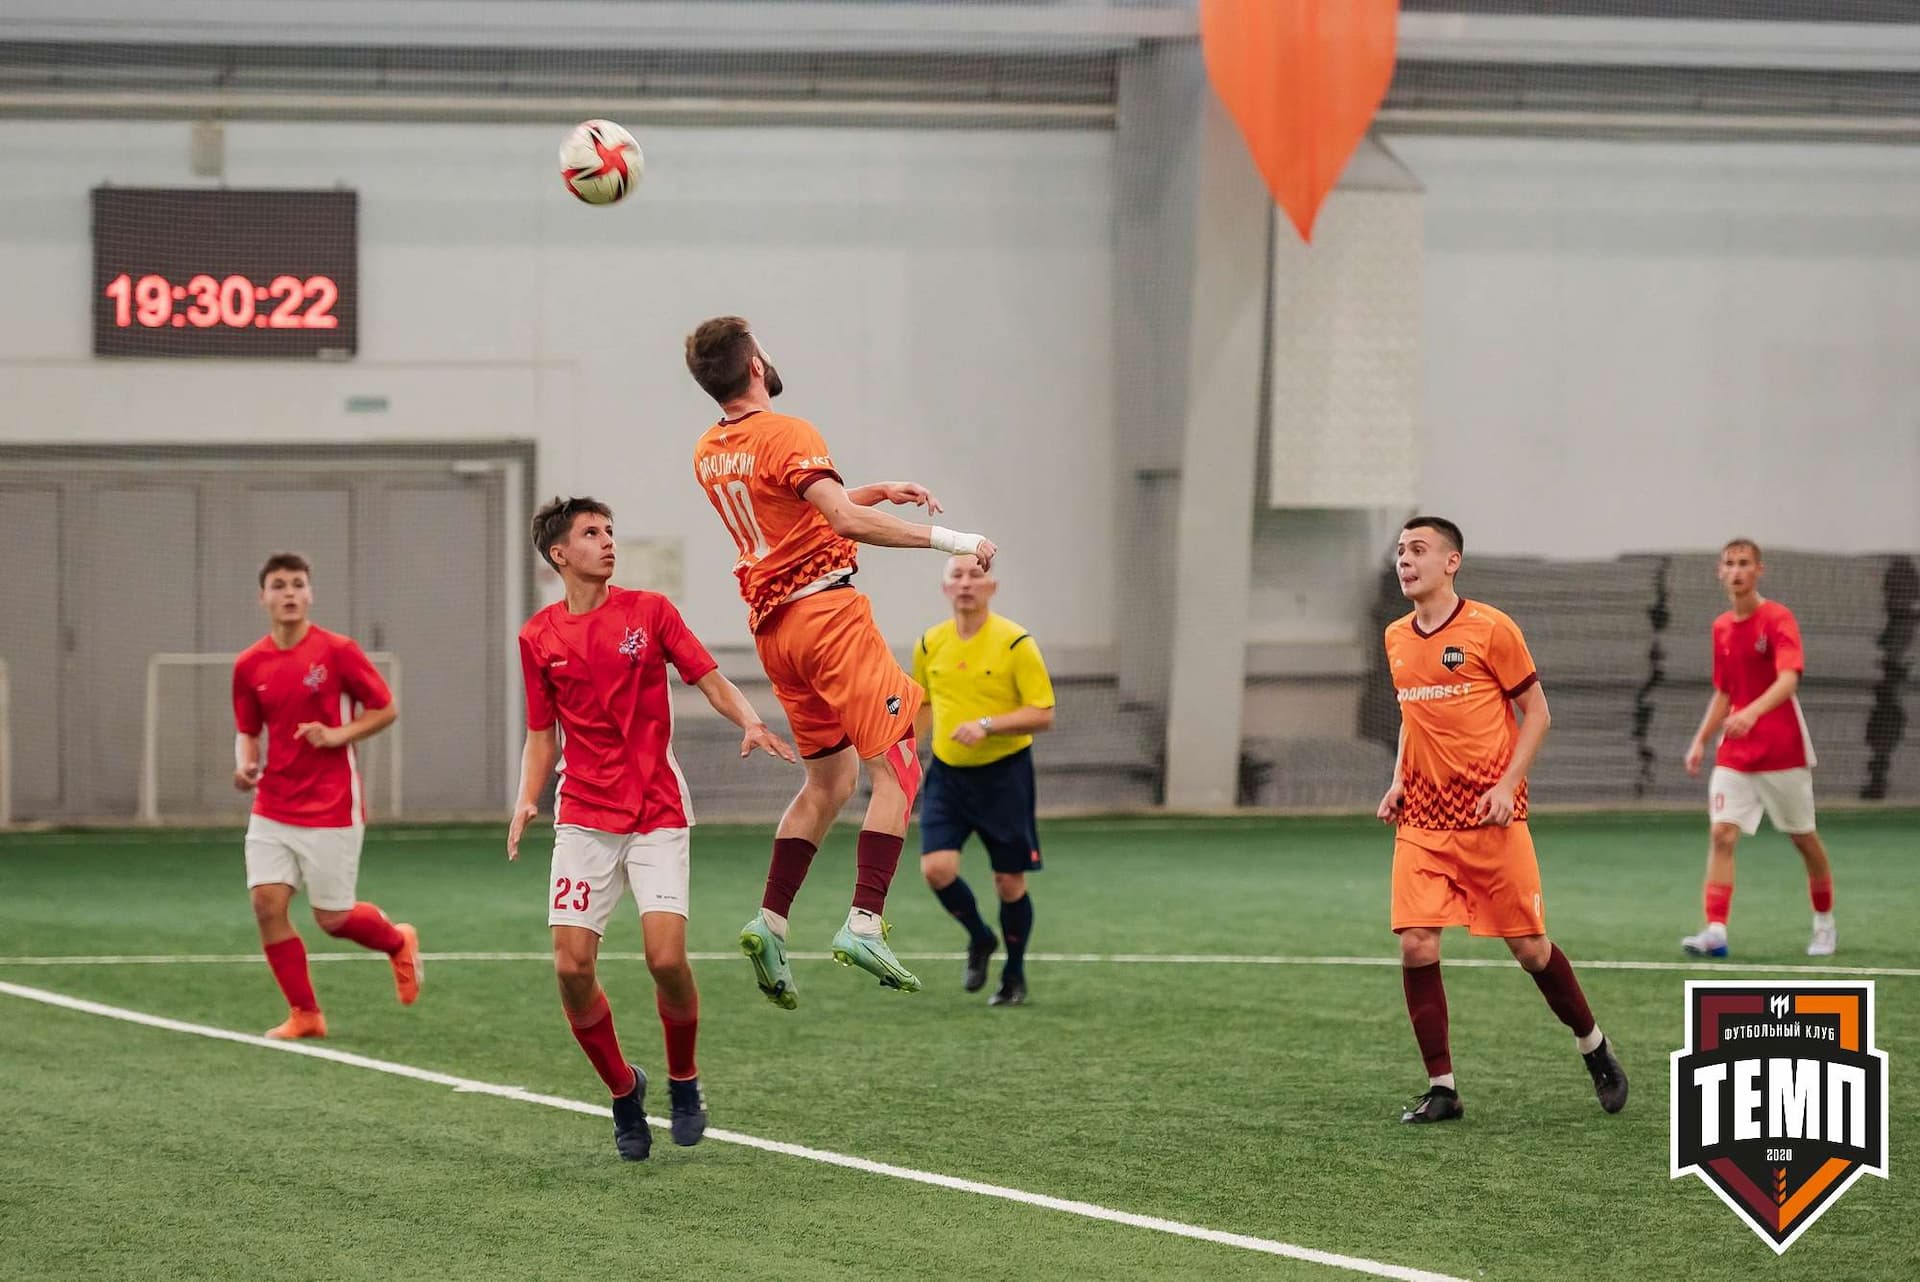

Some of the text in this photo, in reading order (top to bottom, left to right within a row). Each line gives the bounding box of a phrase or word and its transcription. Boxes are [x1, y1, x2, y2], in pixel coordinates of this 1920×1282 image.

[105, 273, 338, 329] 19:30:22
[713, 479, 769, 559] 10
[554, 877, 591, 912] 23
